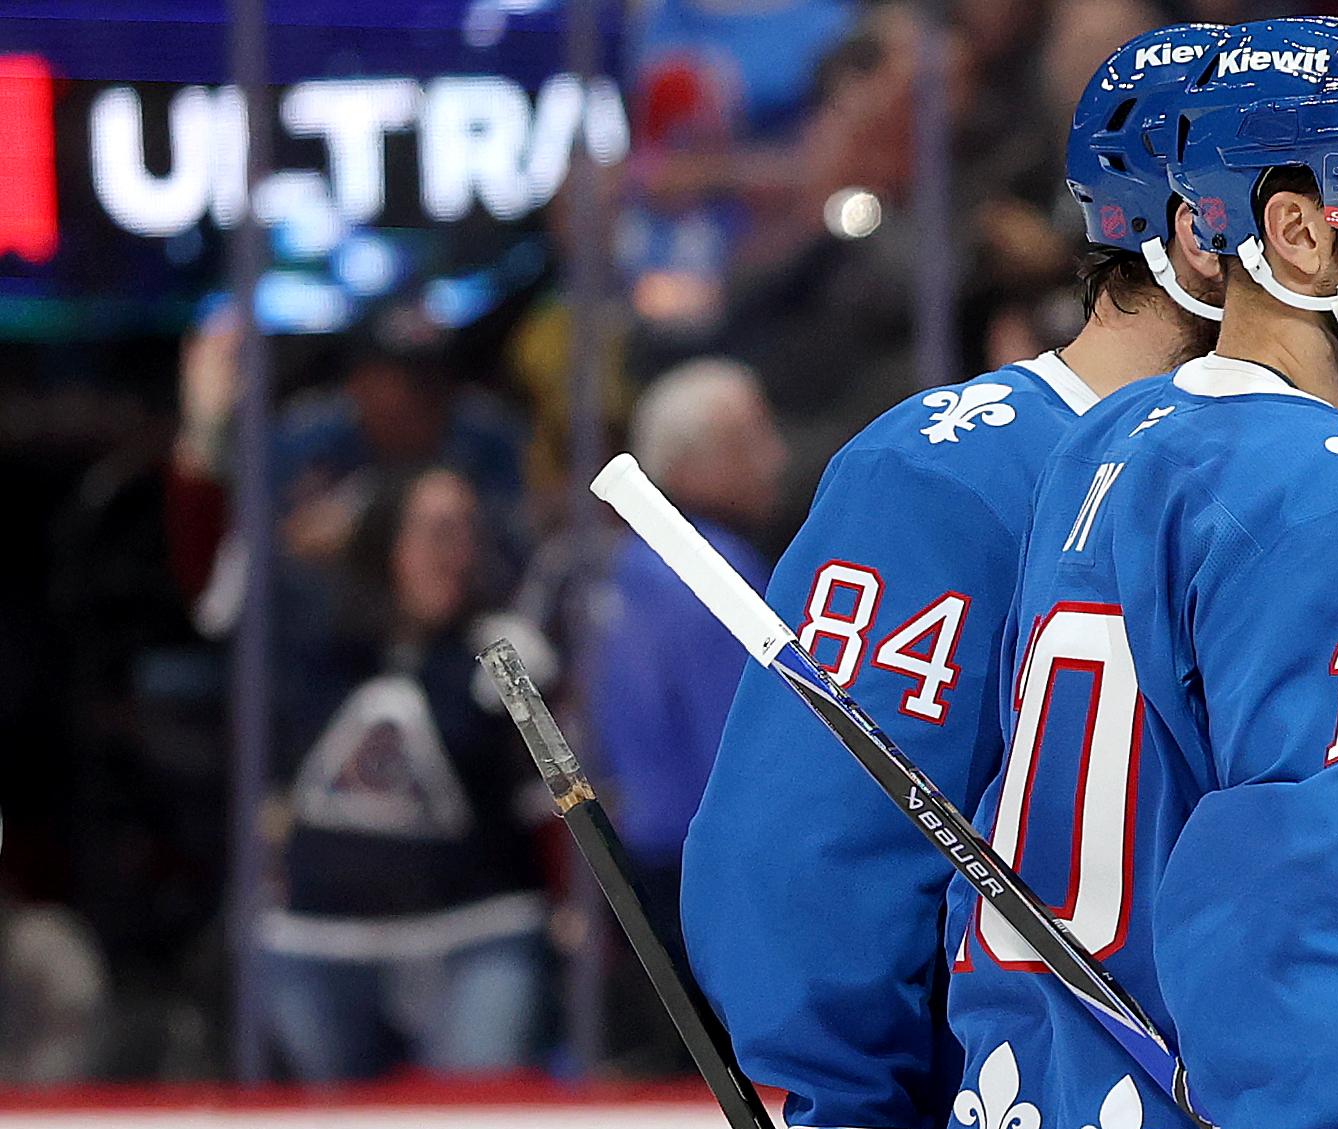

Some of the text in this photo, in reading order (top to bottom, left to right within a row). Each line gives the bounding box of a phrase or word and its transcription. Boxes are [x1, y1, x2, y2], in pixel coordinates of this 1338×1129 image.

[1135, 43, 1209, 70] Kie
[1217, 46, 1330, 78] Kiewit
[798, 559, 972, 725] 84
[917, 810, 1005, 898] BAUER
